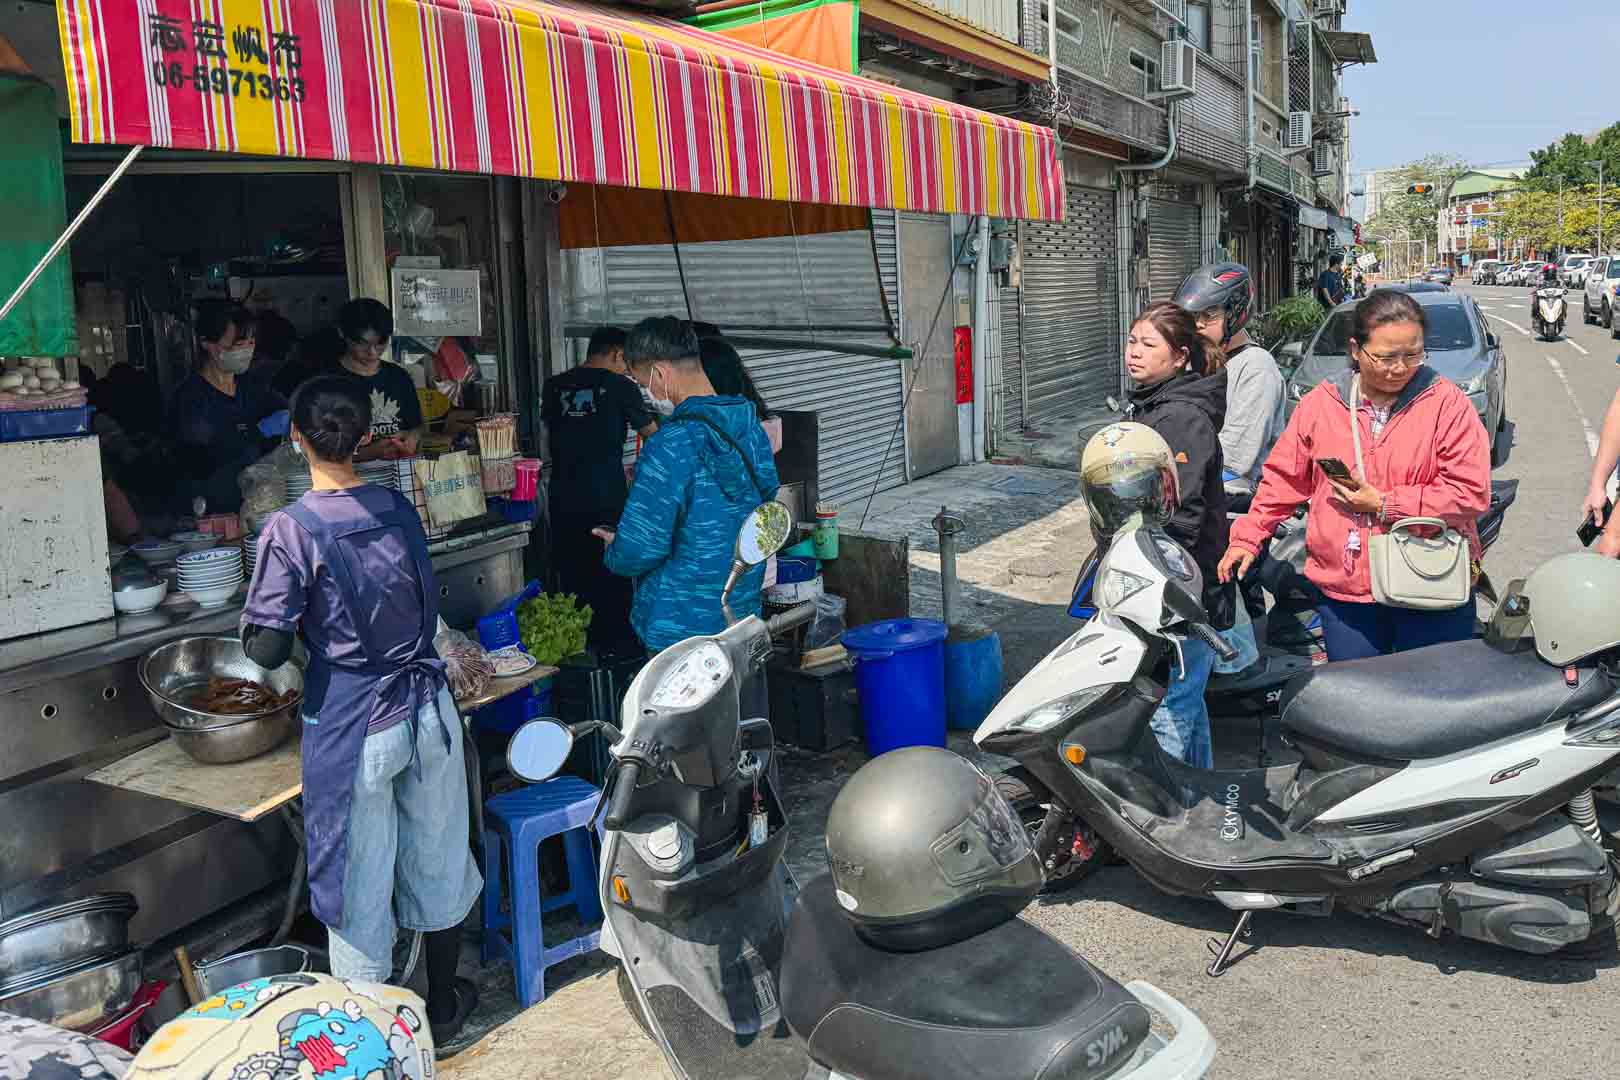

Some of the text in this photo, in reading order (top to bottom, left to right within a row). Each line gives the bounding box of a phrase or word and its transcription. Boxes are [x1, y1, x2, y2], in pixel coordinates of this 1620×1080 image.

[154, 61, 305, 102] 06-5971363
[1266, 689, 1282, 702] SY
[1223, 783, 1240, 826] KYMCO
[1087, 1024, 1129, 1068] SYM
